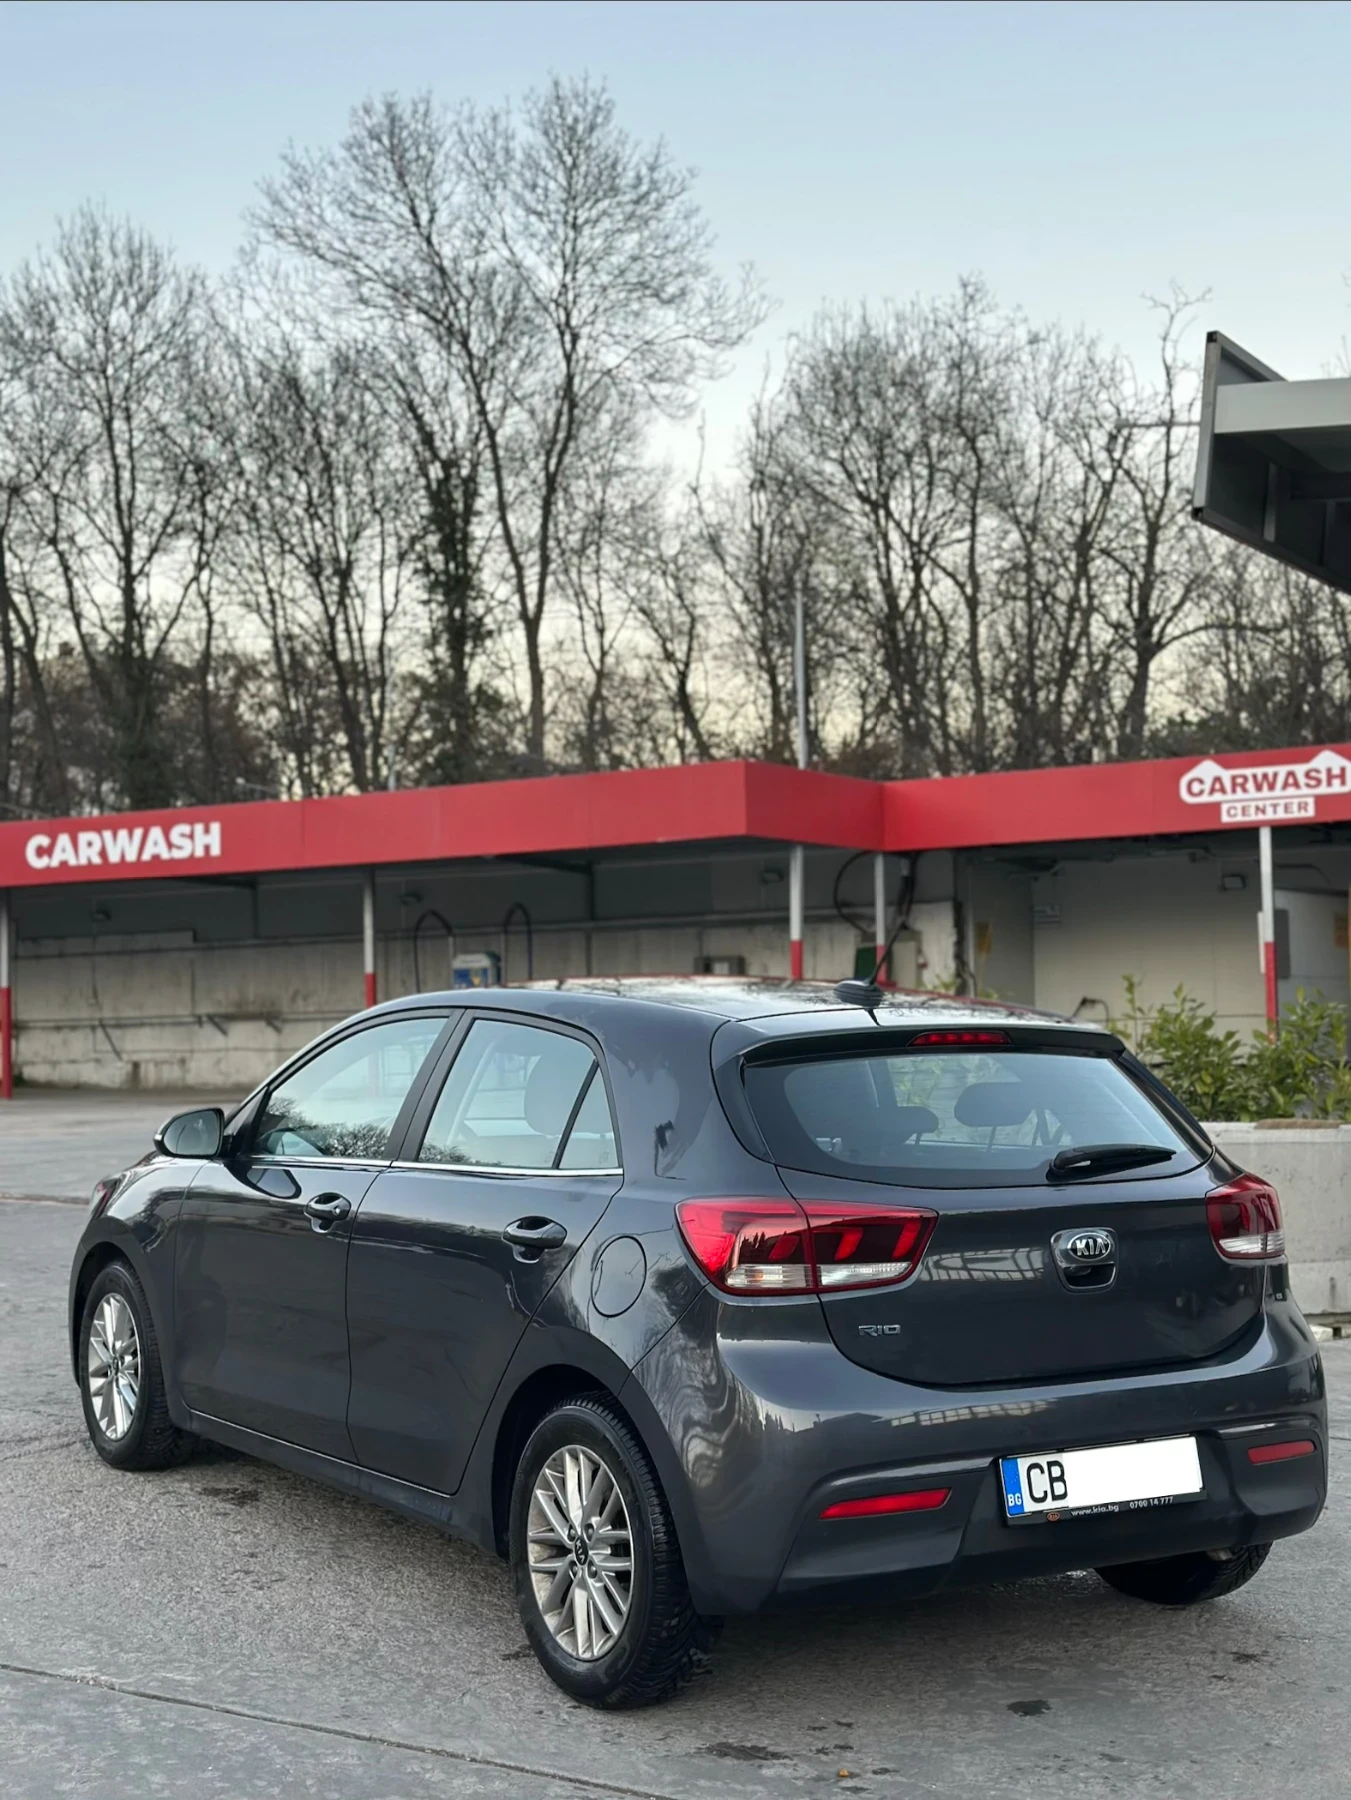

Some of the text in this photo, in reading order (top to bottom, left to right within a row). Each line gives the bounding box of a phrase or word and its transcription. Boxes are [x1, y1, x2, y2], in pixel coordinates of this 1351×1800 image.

[1186, 766, 1347, 798] CARWASH
[1226, 801, 1310, 818] CENTER
[25, 821, 222, 870] CARWASH
[1075, 1238, 1106, 1256] KIA
[858, 1324, 901, 1337] RIO
[1026, 1460, 1069, 1504] CB
[1007, 1492, 1022, 1507] BG
[1129, 1500, 1148, 1509] 0700
[1160, 1496, 1174, 1505] 777
[1070, 1504, 1120, 1517] www.kia.bg
